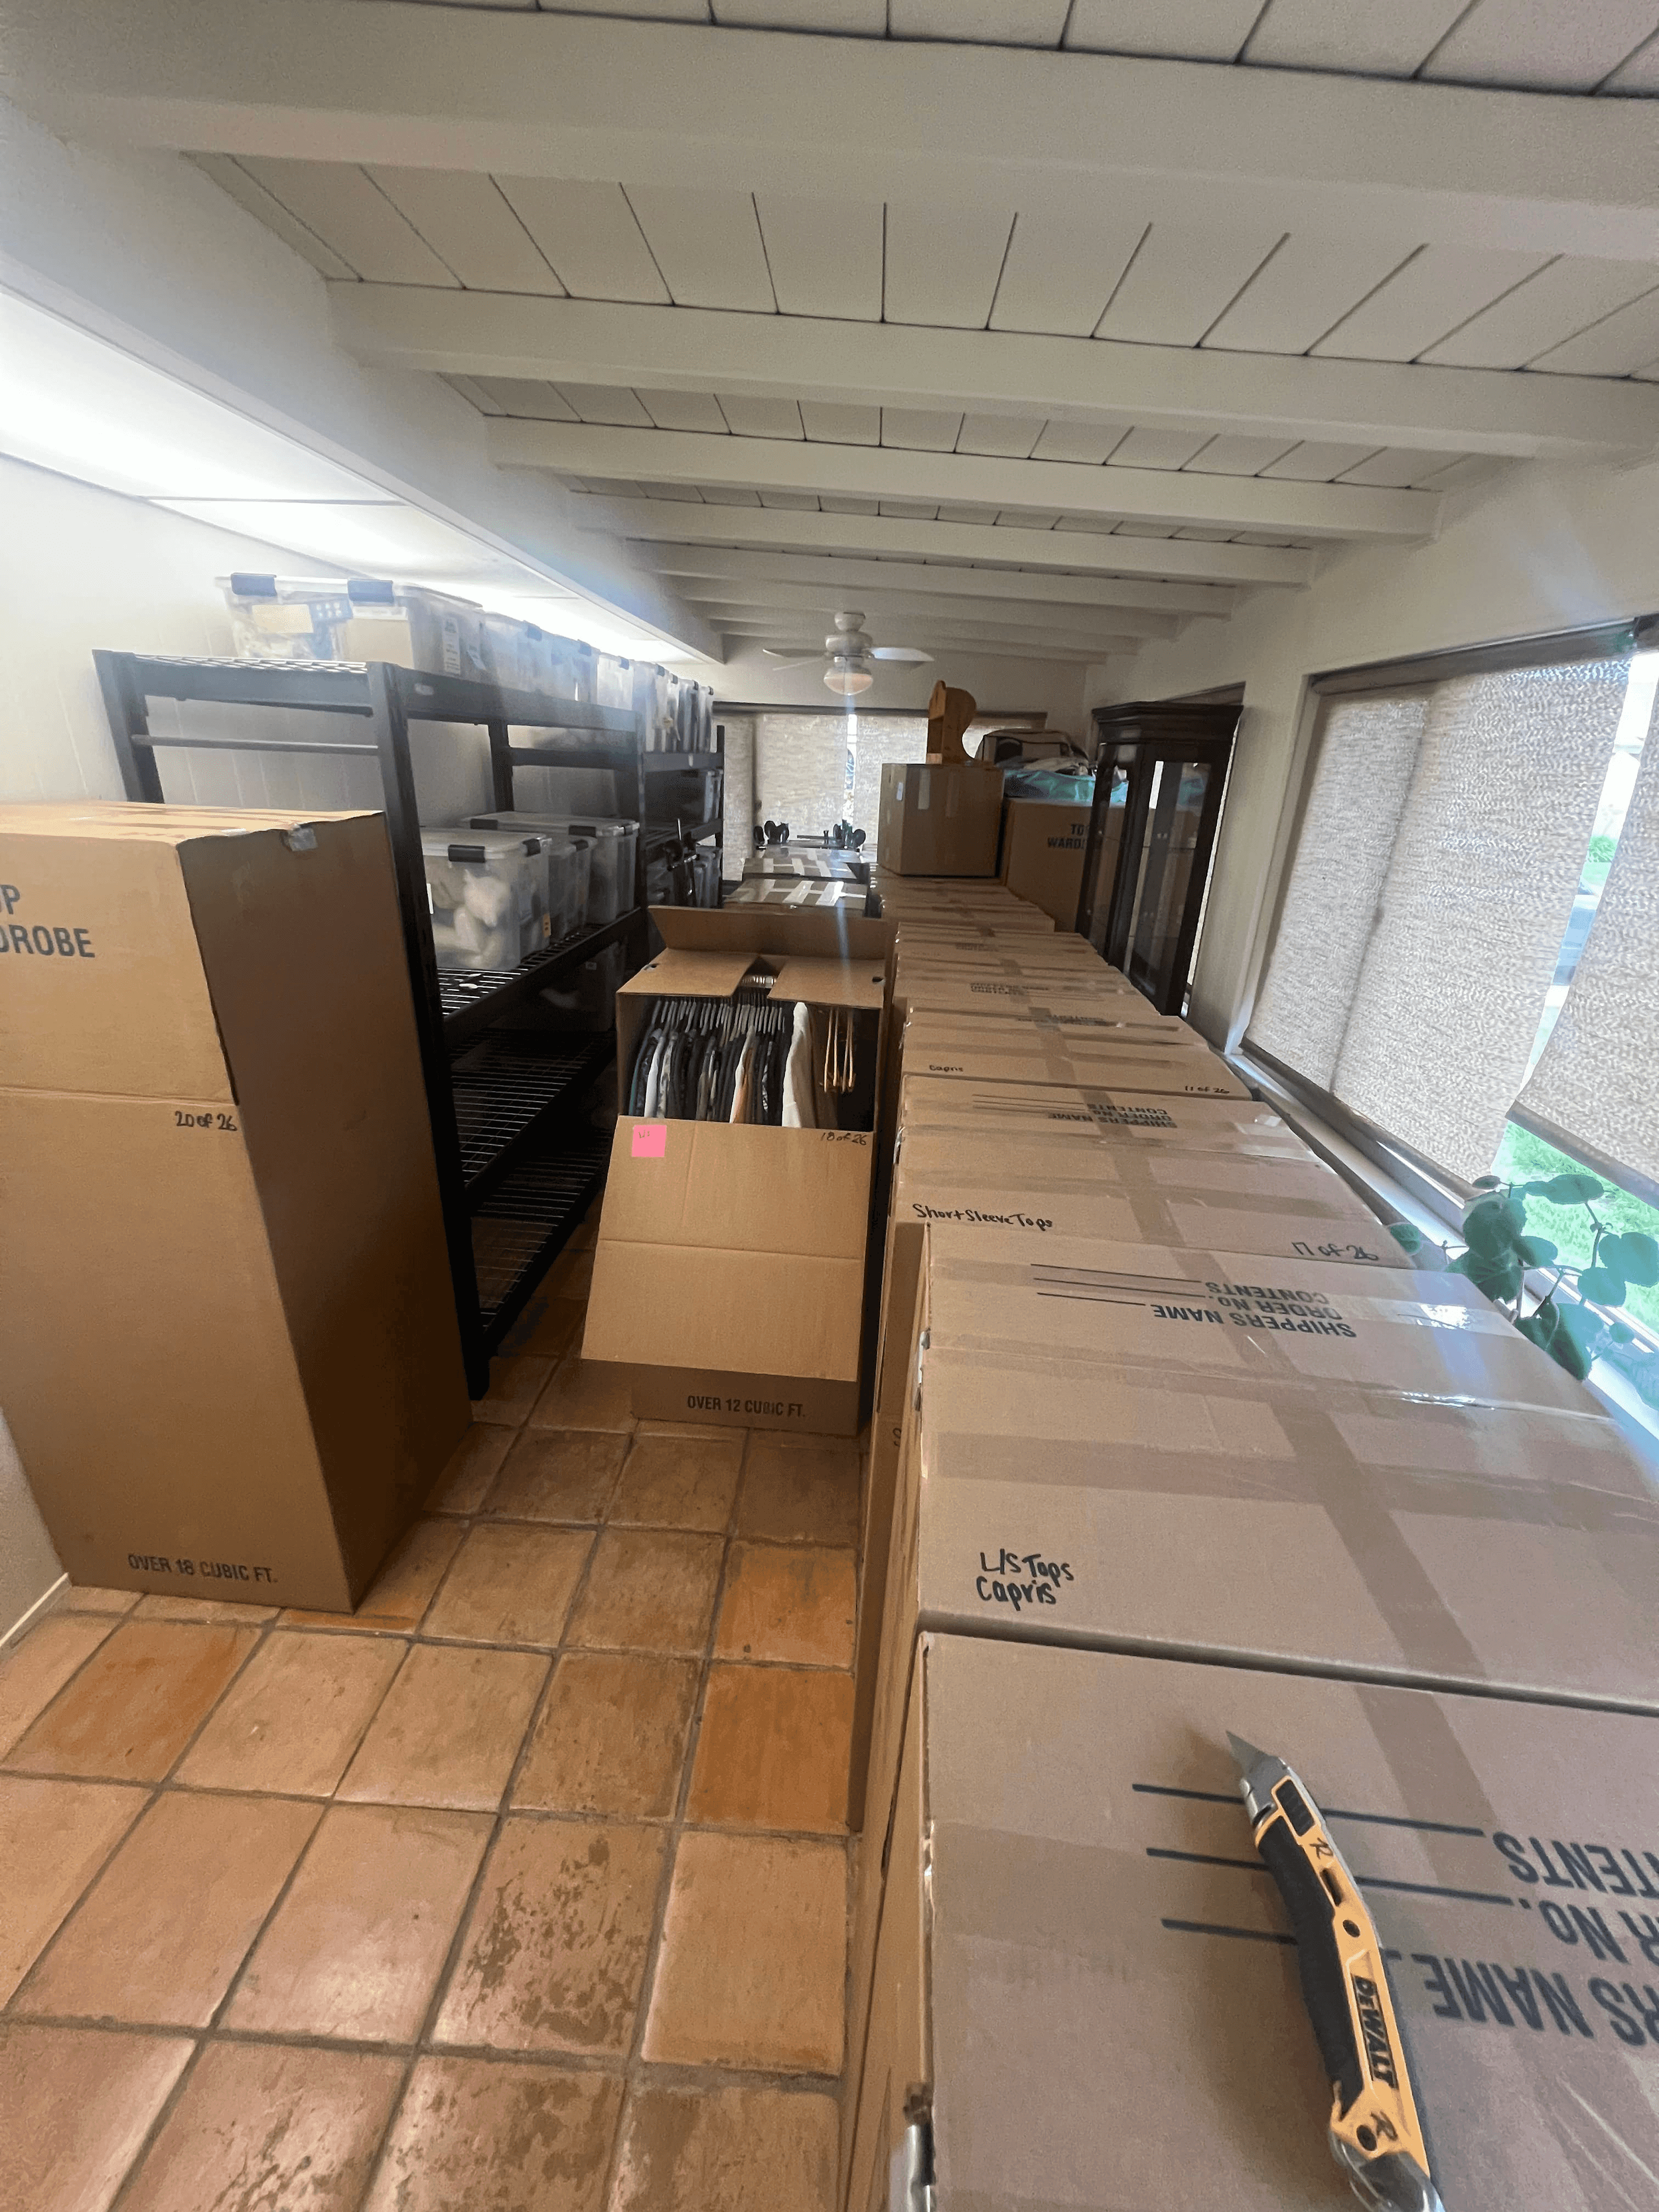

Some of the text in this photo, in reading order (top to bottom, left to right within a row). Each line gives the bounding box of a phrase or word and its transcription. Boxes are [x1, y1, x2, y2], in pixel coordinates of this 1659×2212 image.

[0, 885, 21, 915] P
[175, 1110, 238, 1132] 20 of 26
[1048, 1112, 1178, 1128] SHIPPERS NAME
[1087, 1104, 1168, 1115] CONTENTS
[1116, 1111, 1173, 1122] ORDER
[821, 1131, 867, 1145] 18 of 26
[912, 1203, 1053, 1232] Short Sleeve Tops
[1318, 1243, 1345, 1256] of
[1205, 1282, 1331, 1305] CONTENTS
[1151, 1303, 1357, 1338] SHIPPERS NAME
[1255, 1299, 1343, 1321] ORDER
[687, 1395, 806, 1418] OVER 12 CUBIC FT.
[127, 1554, 172, 1573] OVER
[176, 1559, 194, 1576] 18
[200, 1561, 250, 1581] CUBIC
[1021, 1553, 1074, 1588] Tops
[976, 1576, 1056, 1611] Capris
[1410, 1952, 1595, 2041] NAME
[1352, 1975, 1400, 2091] DEWALT
